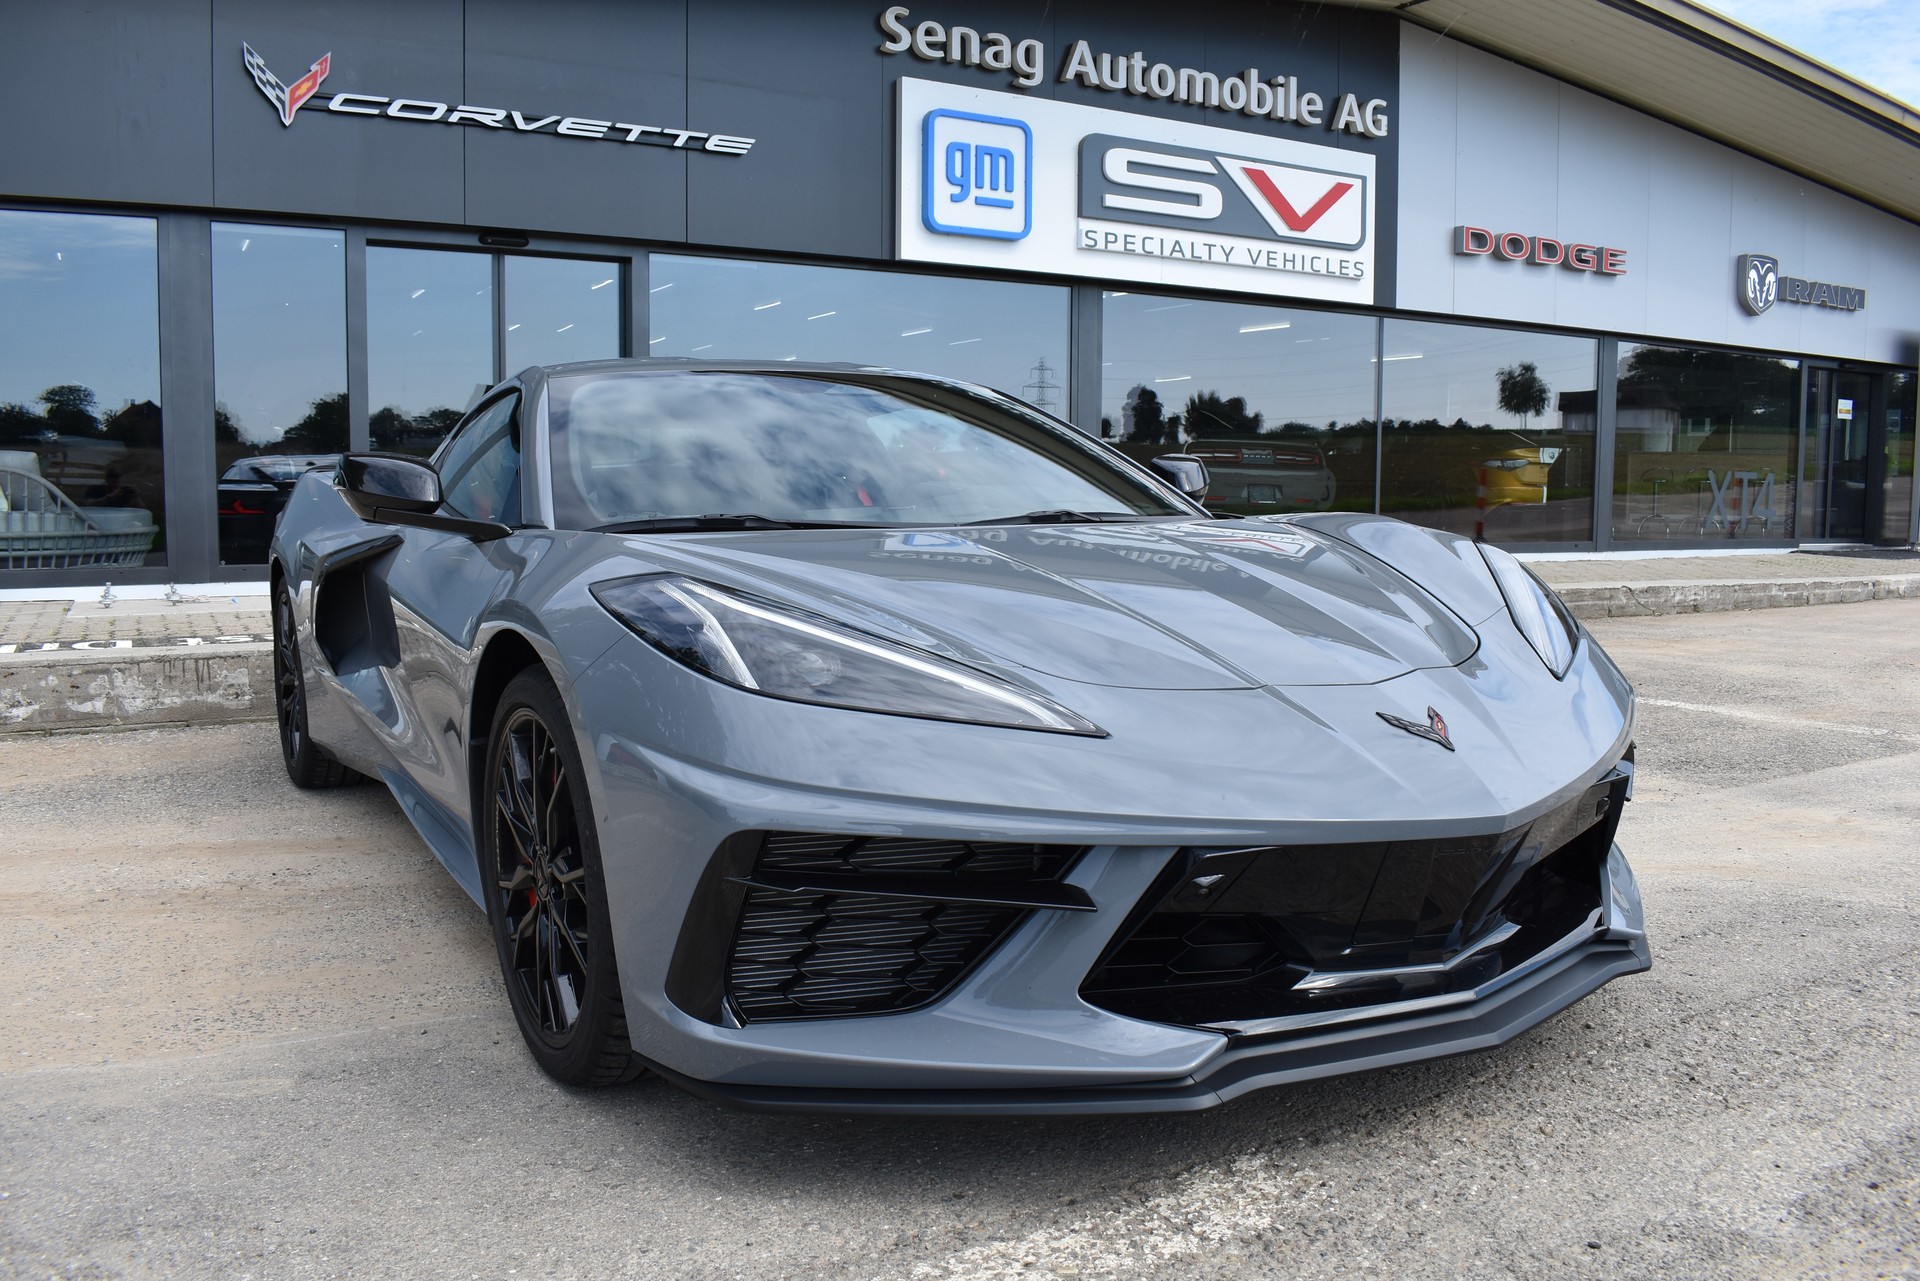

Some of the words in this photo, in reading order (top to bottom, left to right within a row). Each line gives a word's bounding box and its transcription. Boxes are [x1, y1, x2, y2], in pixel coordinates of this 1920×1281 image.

[881, 6, 1044, 88] Senag
[1060, 39, 1324, 126] Automobile
[1331, 93, 1389, 138] AG
[327, 92, 756, 156] CORVETTE
[945, 140, 1015, 204] gm
[1102, 147, 1355, 233] SV
[1083, 228, 1236, 264] SPECIALTY
[1246, 246, 1365, 279] VEHICLES
[1457, 225, 1628, 275] DODGE
[1782, 276, 1866, 311] RAM
[1704, 468, 1777, 530] XT4
